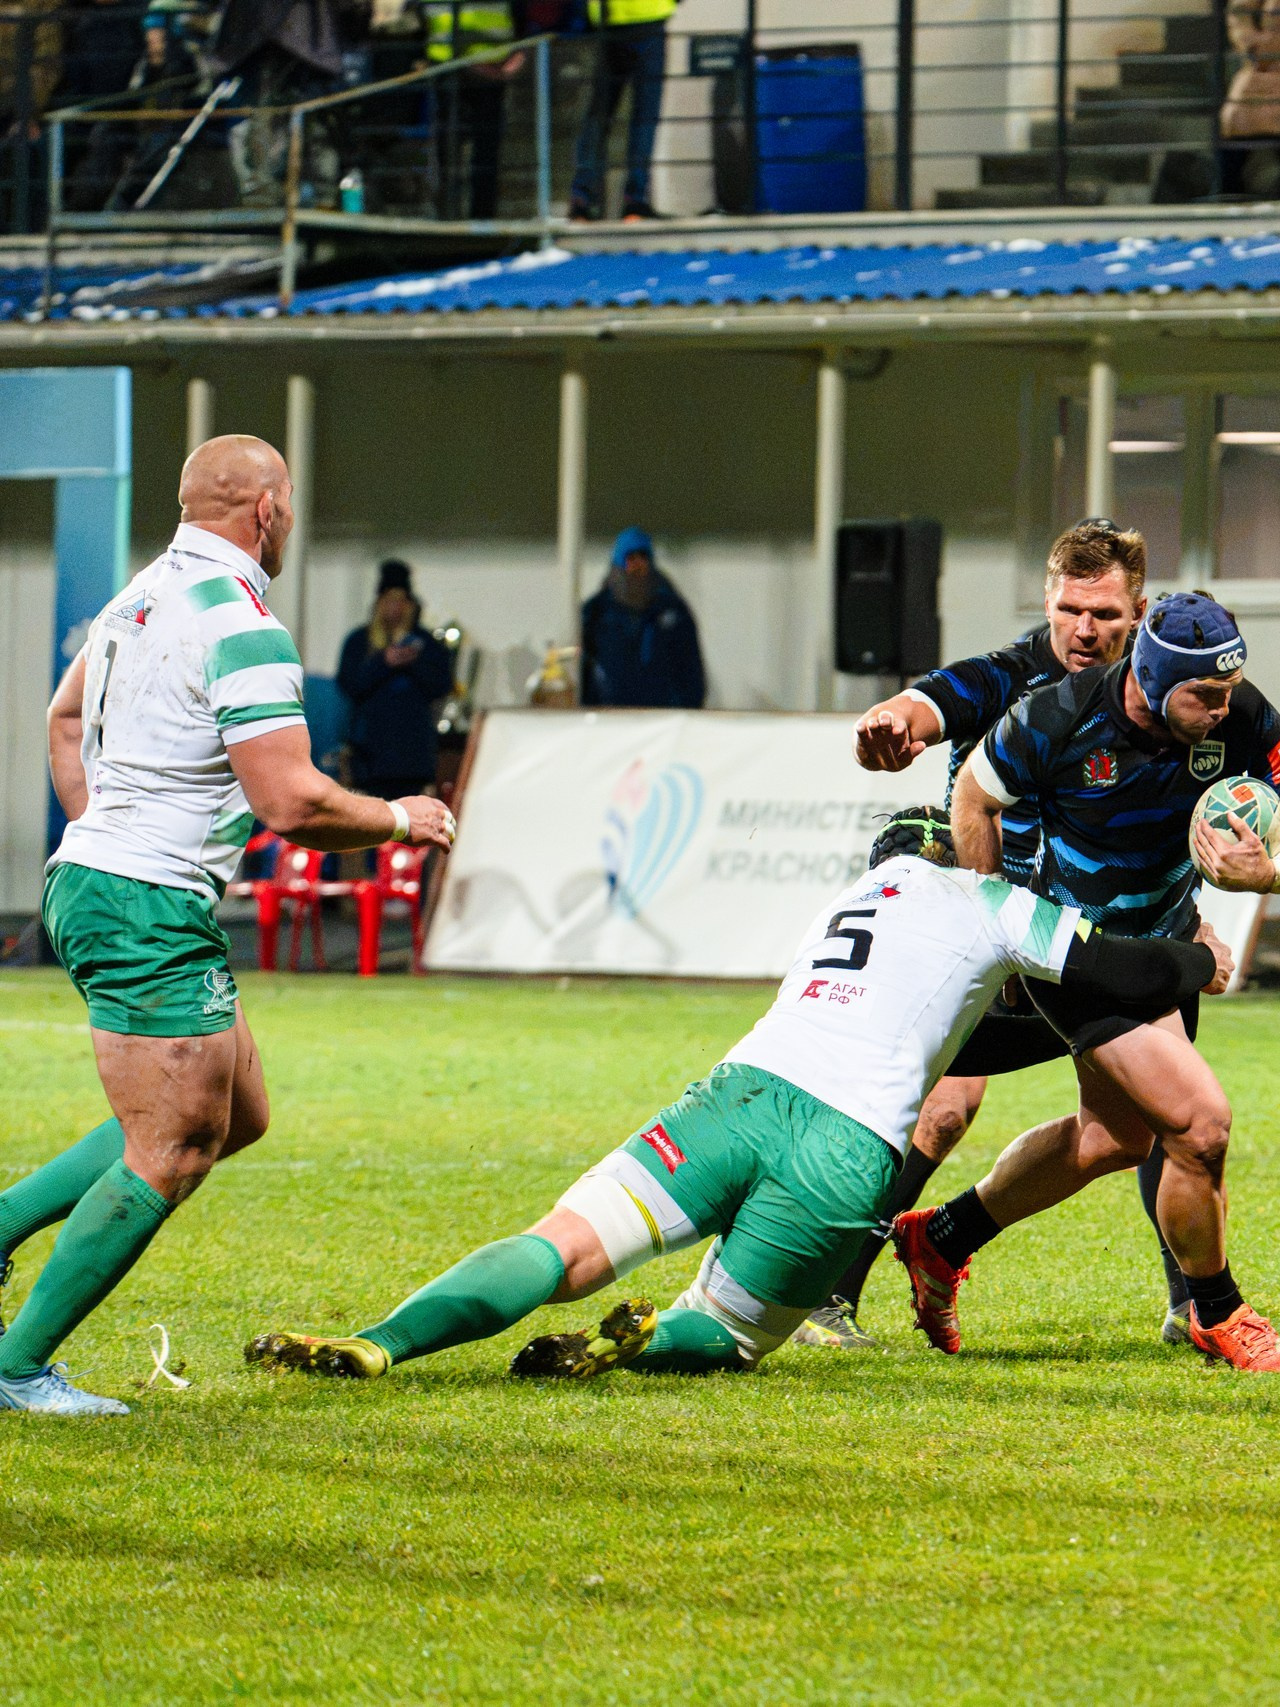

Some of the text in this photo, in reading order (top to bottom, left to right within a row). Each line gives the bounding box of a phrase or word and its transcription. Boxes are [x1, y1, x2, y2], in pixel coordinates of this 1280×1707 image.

[811, 908, 878, 971] 5
[831, 982, 867, 997] АГАТ
[828, 992, 850, 1005] РФ
